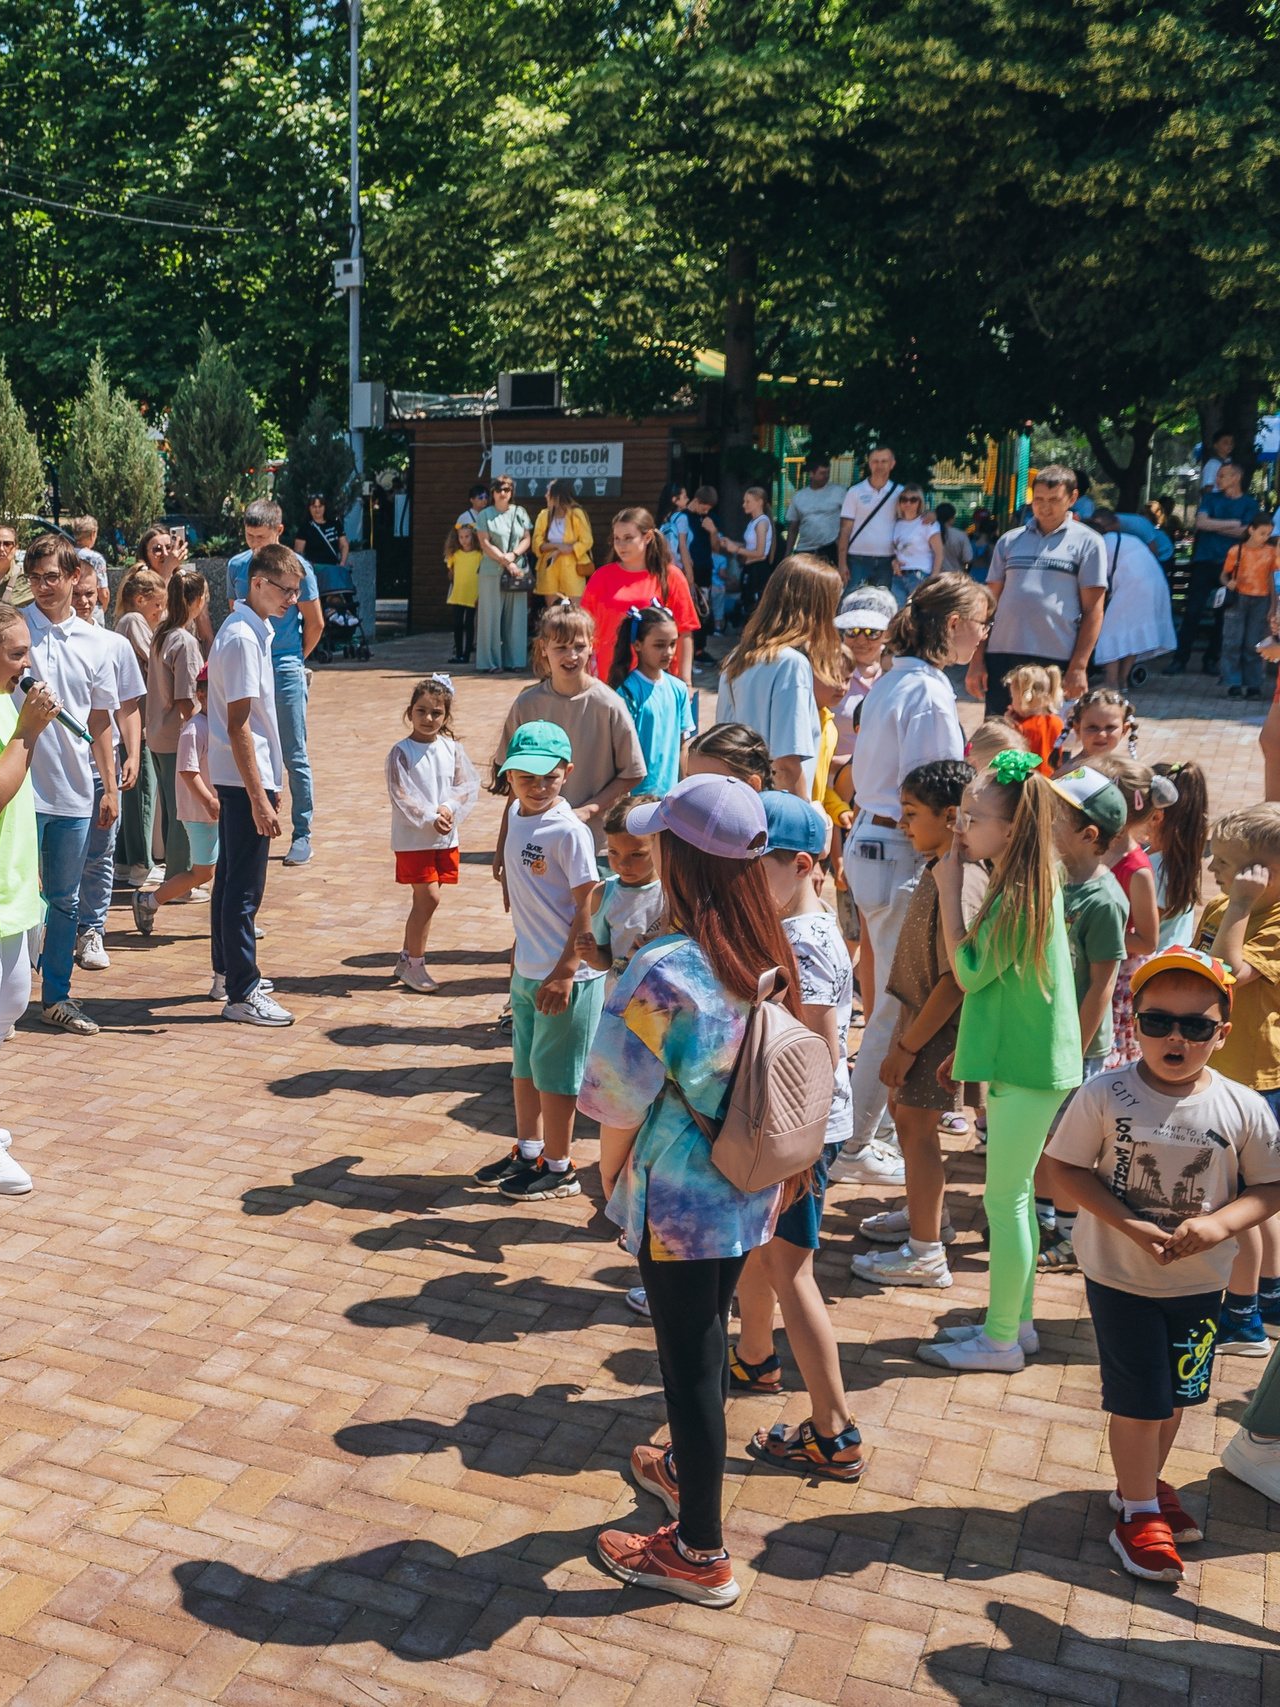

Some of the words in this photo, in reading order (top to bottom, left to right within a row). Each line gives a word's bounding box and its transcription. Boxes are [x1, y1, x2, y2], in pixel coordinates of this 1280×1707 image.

[505, 449, 544, 465] КОФЕ
[548, 449, 557, 464] С
[560, 445, 609, 464] СОБОЙ
[505, 465, 552, 477] COFFEE
[562, 465, 579, 476] TO
[586, 465, 608, 476] GO
[1111, 1080, 1140, 1108] CITY
[1115, 1117, 1133, 1143] LOS
[1152, 1128, 1185, 1142] AMAZING
[1159, 1122, 1182, 1133] WANT
[1186, 1128, 1197, 1137] TO
